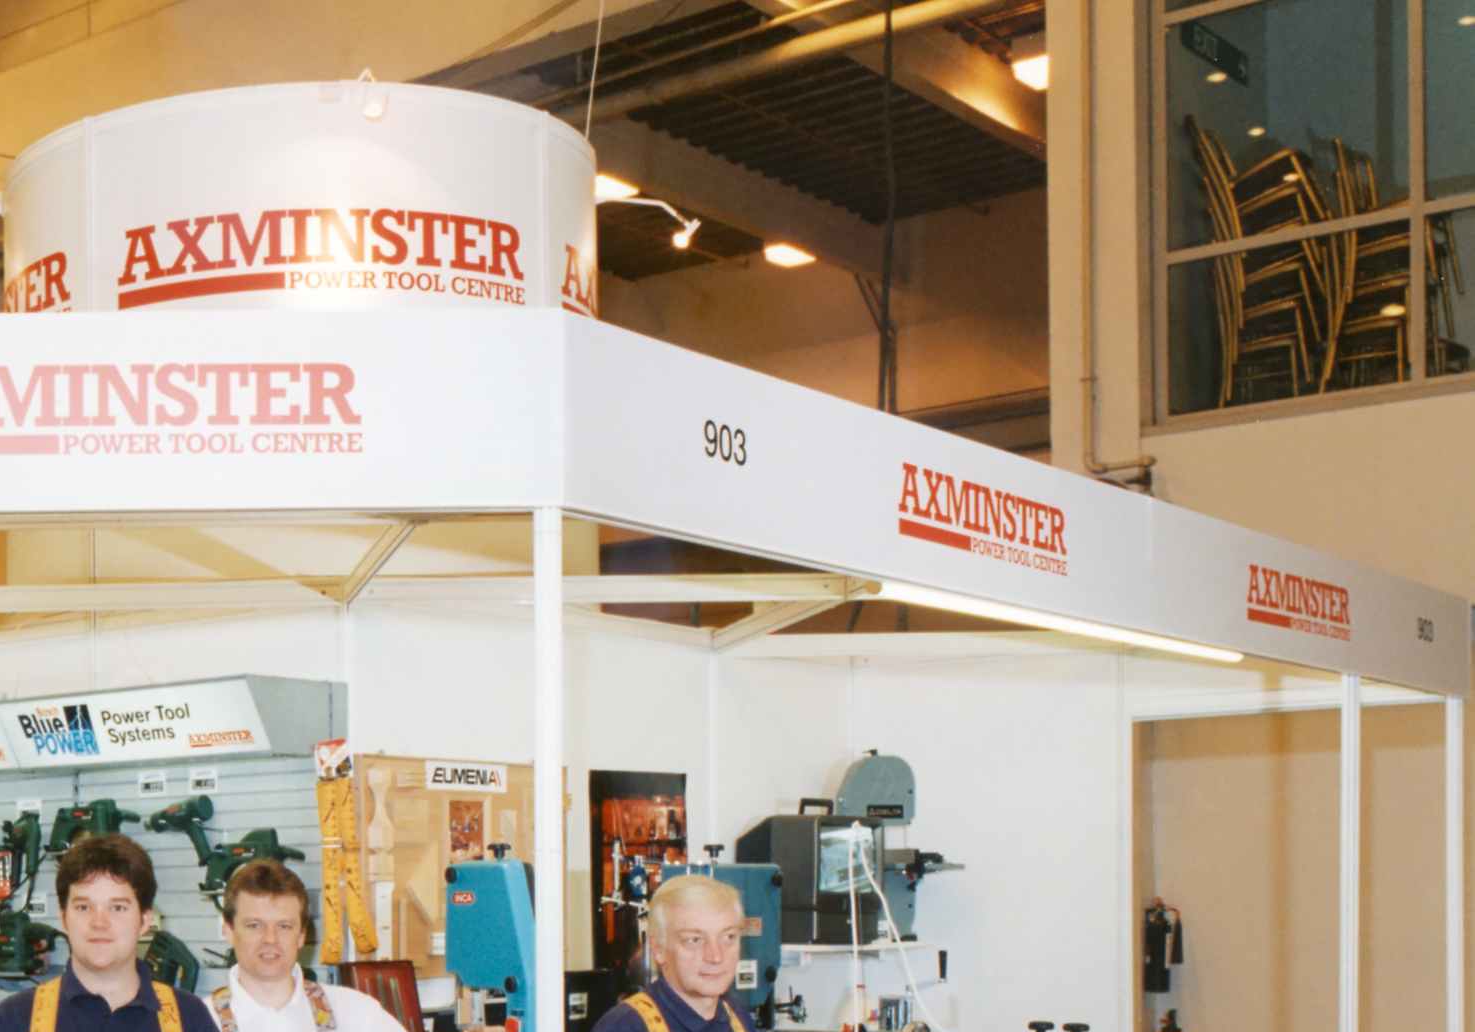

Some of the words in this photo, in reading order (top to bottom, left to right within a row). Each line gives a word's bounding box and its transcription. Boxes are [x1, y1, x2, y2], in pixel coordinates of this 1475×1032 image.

[117, 208, 525, 287] AXMINSTER
[289, 270, 377, 290] POWER
[383, 271, 446, 293] TOOL
[451, 277, 525, 305] CENTRE
[63, 433, 161, 456] POWER
[169, 432, 244, 455] TOOL
[251, 431, 364, 454] CENTRE
[704, 420, 747, 466] 903
[898, 462, 1067, 555] AXMINSTER
[972, 537, 1005, 562] POWER
[1007, 546, 1032, 568] TOOL
[1033, 553, 1068, 577] CENTRE
[1247, 564, 1350, 625] AXMINSTER
[1417, 617, 1434, 642] 903
[100, 708, 150, 726] Power
[155, 703, 190, 721] Tool
[33, 730, 99, 756] POWER
[107, 726, 175, 746] Systems
[188, 730, 254, 744] AXMINSTER
[432, 766, 498, 788] EUMENIA
[454, 893, 471, 902] INCA
